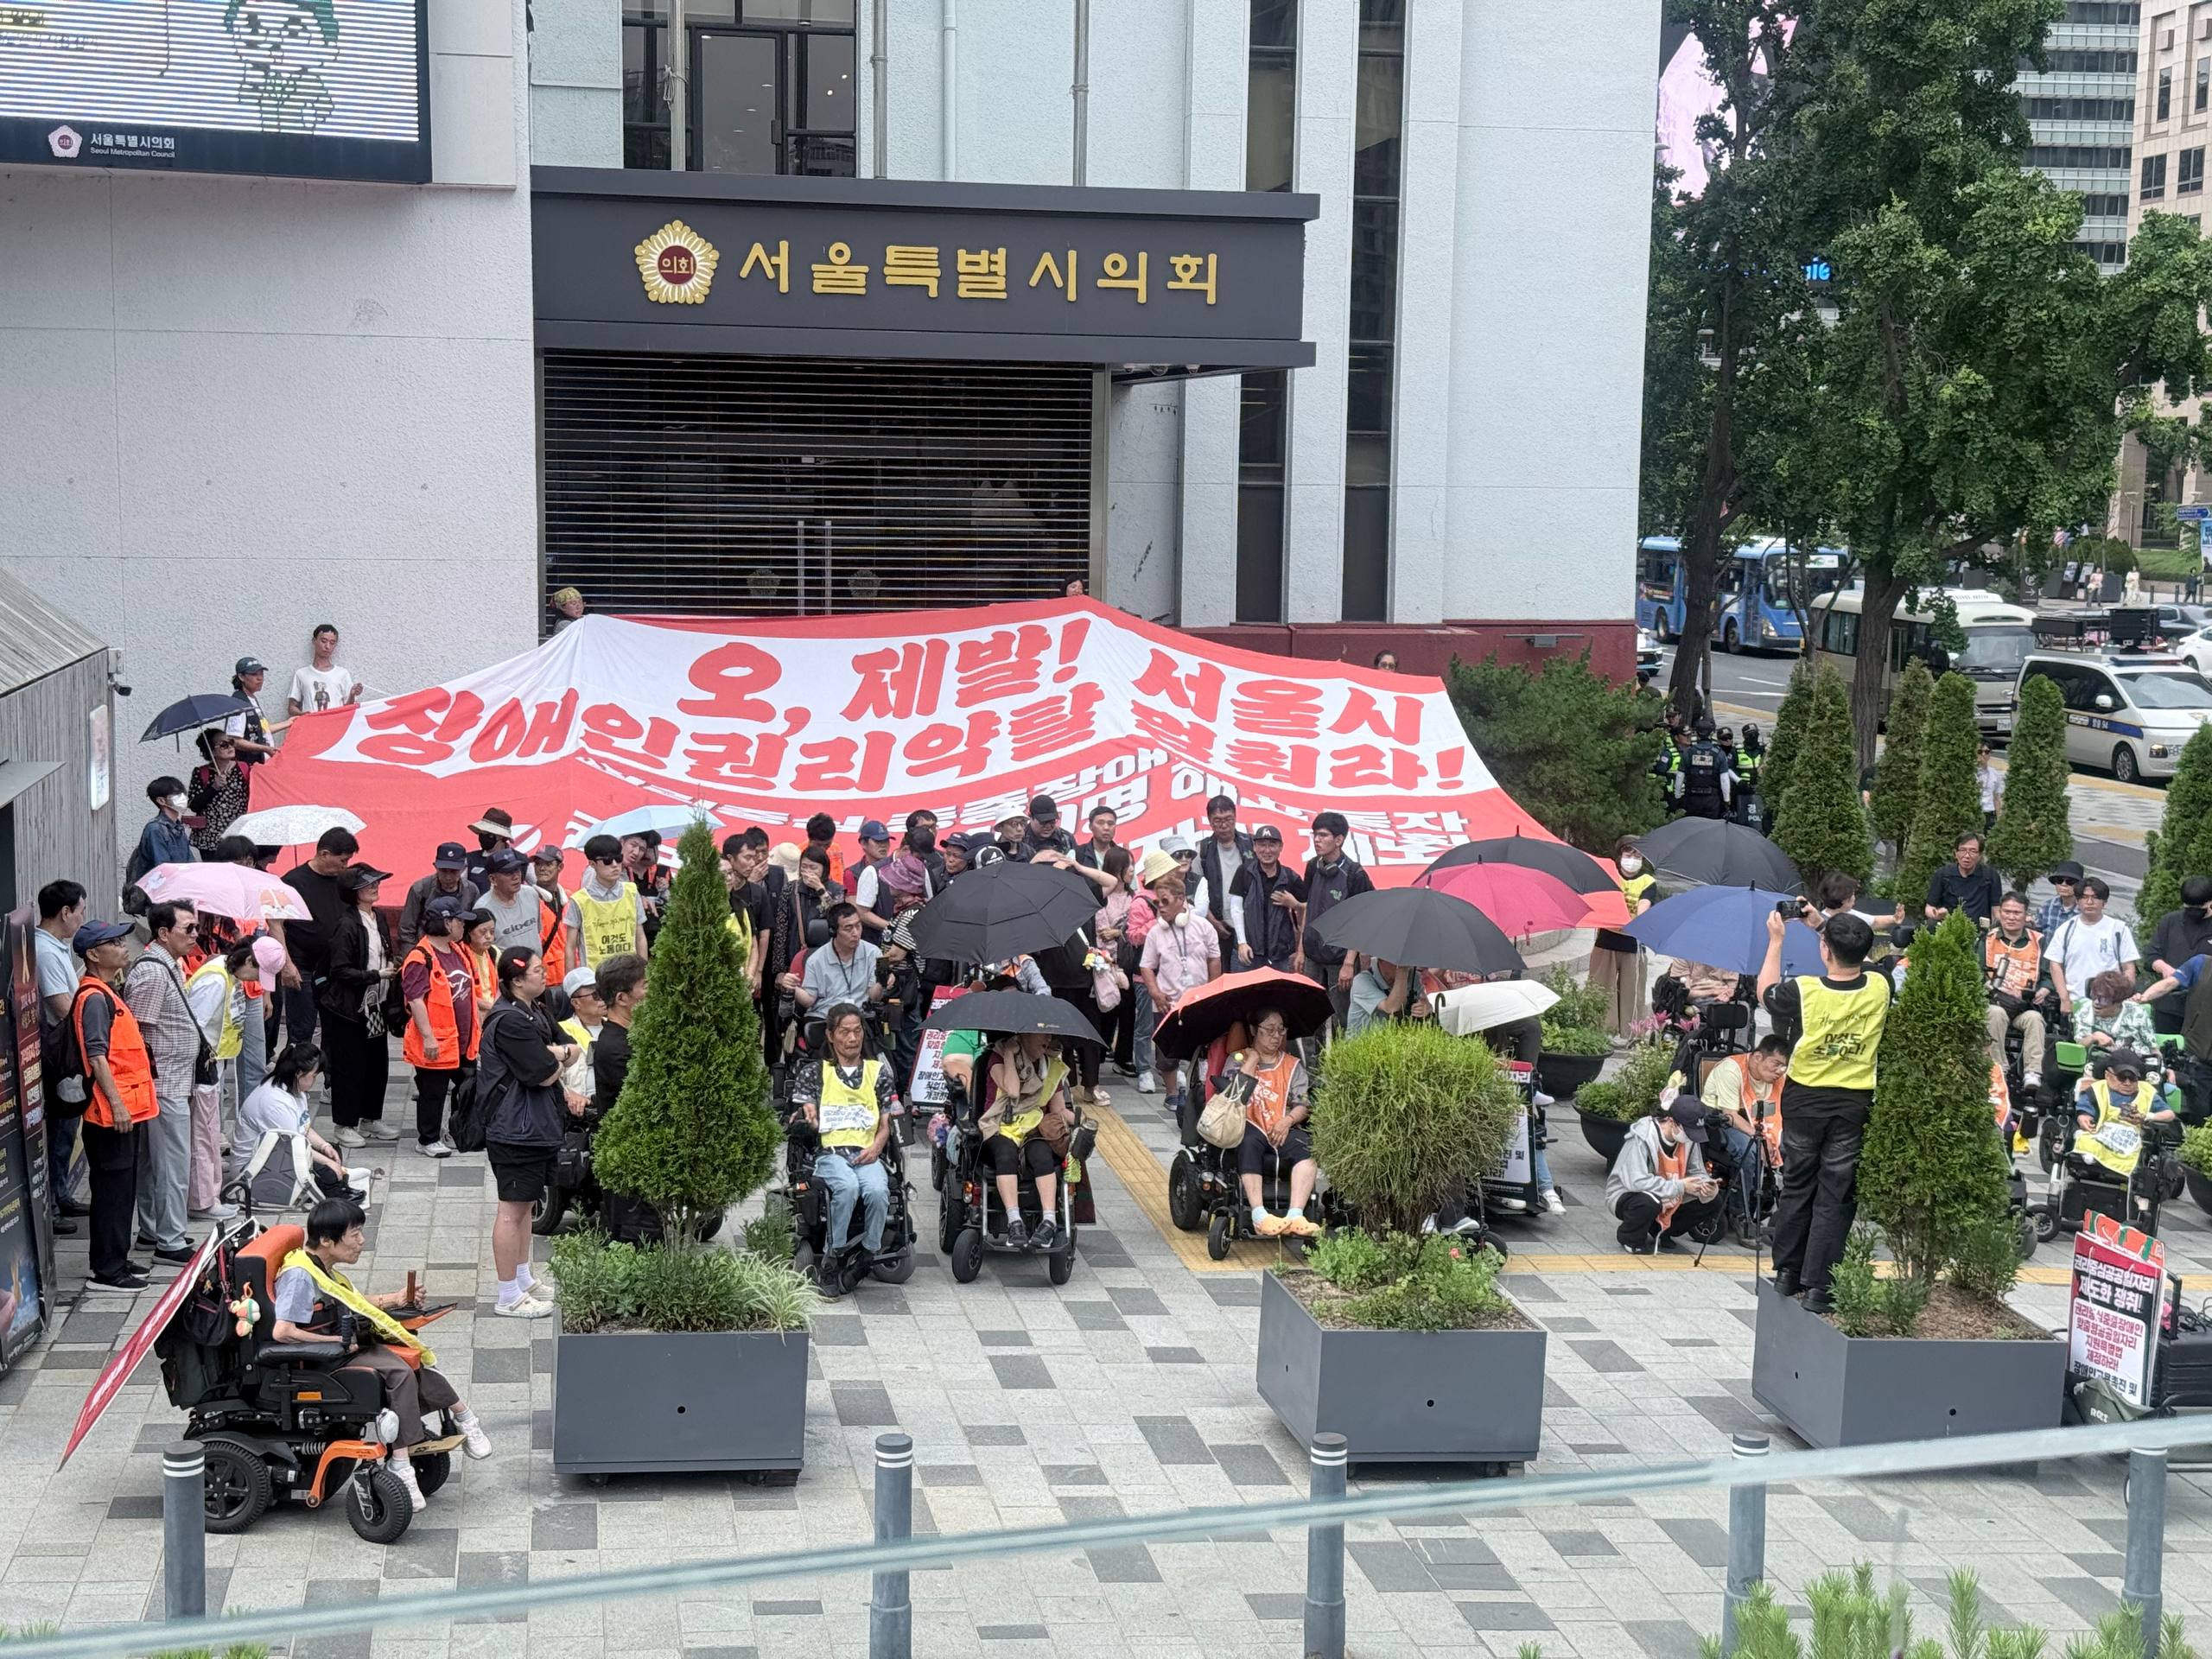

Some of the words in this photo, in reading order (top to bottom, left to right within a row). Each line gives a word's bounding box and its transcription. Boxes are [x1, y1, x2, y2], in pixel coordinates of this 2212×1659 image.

[91, 133, 175, 149] 서울특별시의회
[111, 148, 149, 157] Metropolitan
[660, 255, 694, 275] 의회
[739, 239, 1217, 305] 서울특별시의회
[677, 641, 812, 739] 오,
[840, 618, 1091, 721] 제발!
[1132, 647, 1424, 744] 서울시
[601, 933, 626, 944] 이것도
[1825, 1033, 1862, 1045] 이것도
[2074, 1255, 2154, 1294] 권리중심공공일자리
[2079, 1274, 2112, 1303] 제도화
[2113, 1287, 2144, 1313] 쟁취!
